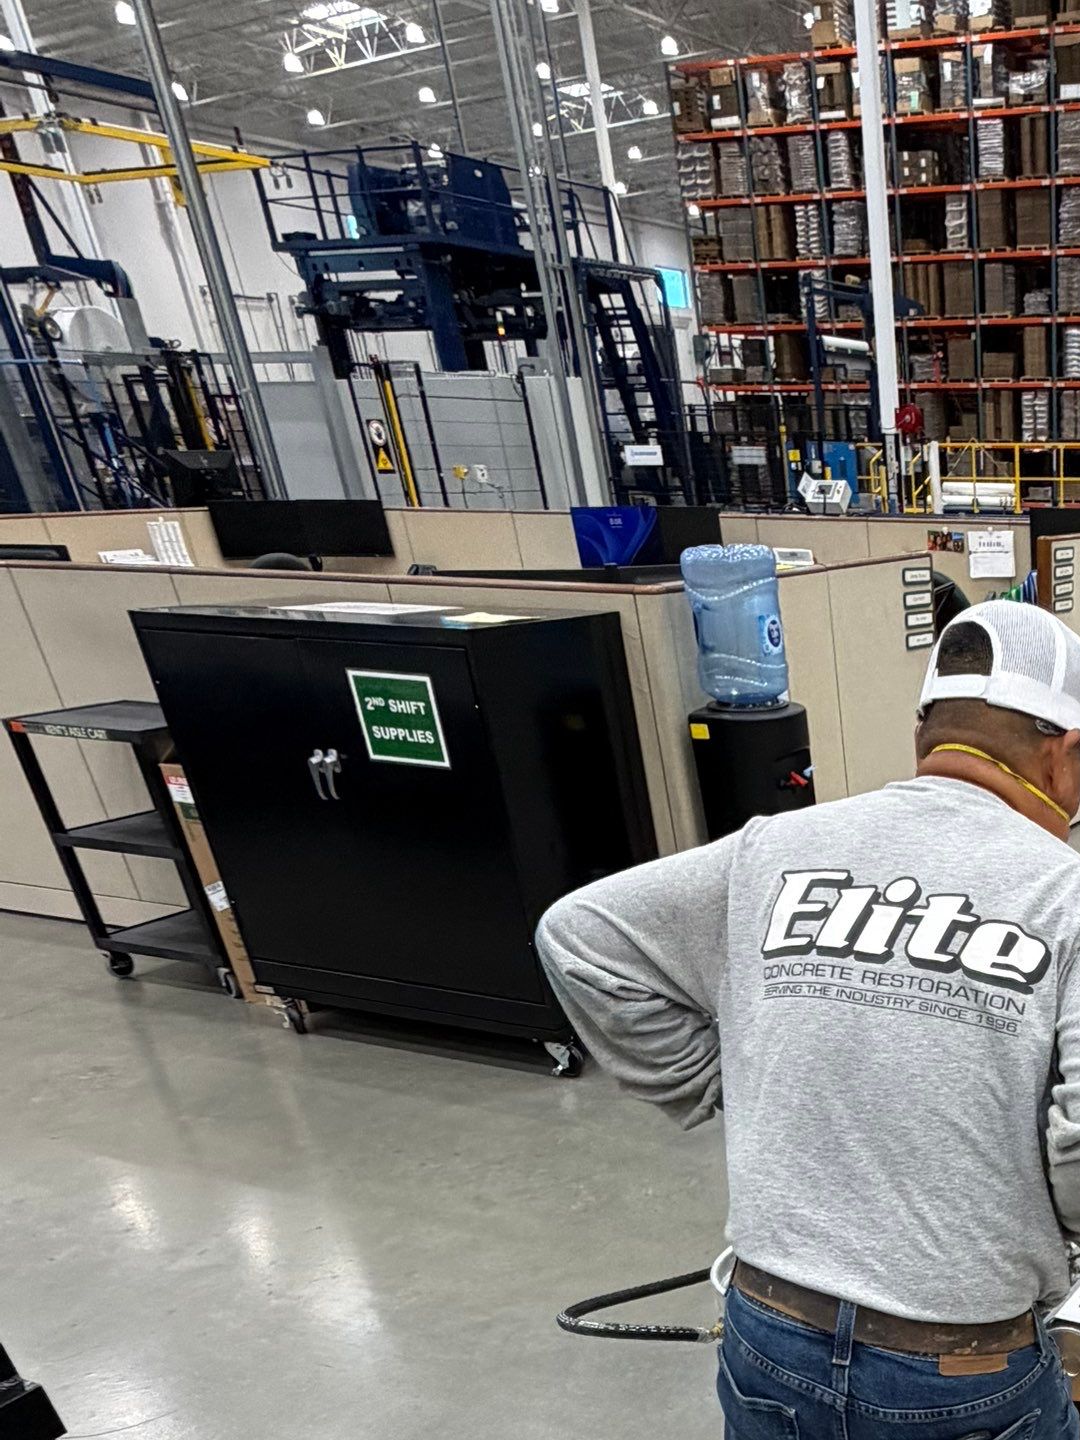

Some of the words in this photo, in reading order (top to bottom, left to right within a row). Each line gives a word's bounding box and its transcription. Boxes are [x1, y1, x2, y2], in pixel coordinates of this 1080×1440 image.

[364, 696, 385, 711] 2ND
[388, 698, 426, 715] SHIFT
[87, 728, 108, 740] CART
[371, 725, 435, 744] SUPPLIES
[761, 868, 1052, 995] Elite
[764, 962, 854, 981] CONCRETE
[860, 970, 1026, 1016] RESTORATION
[806, 985, 832, 996] THE
[836, 988, 914, 1009] INDUSTRY
[918, 1001, 969, 1019] SINCE
[975, 1013, 1018, 1033] 1996
